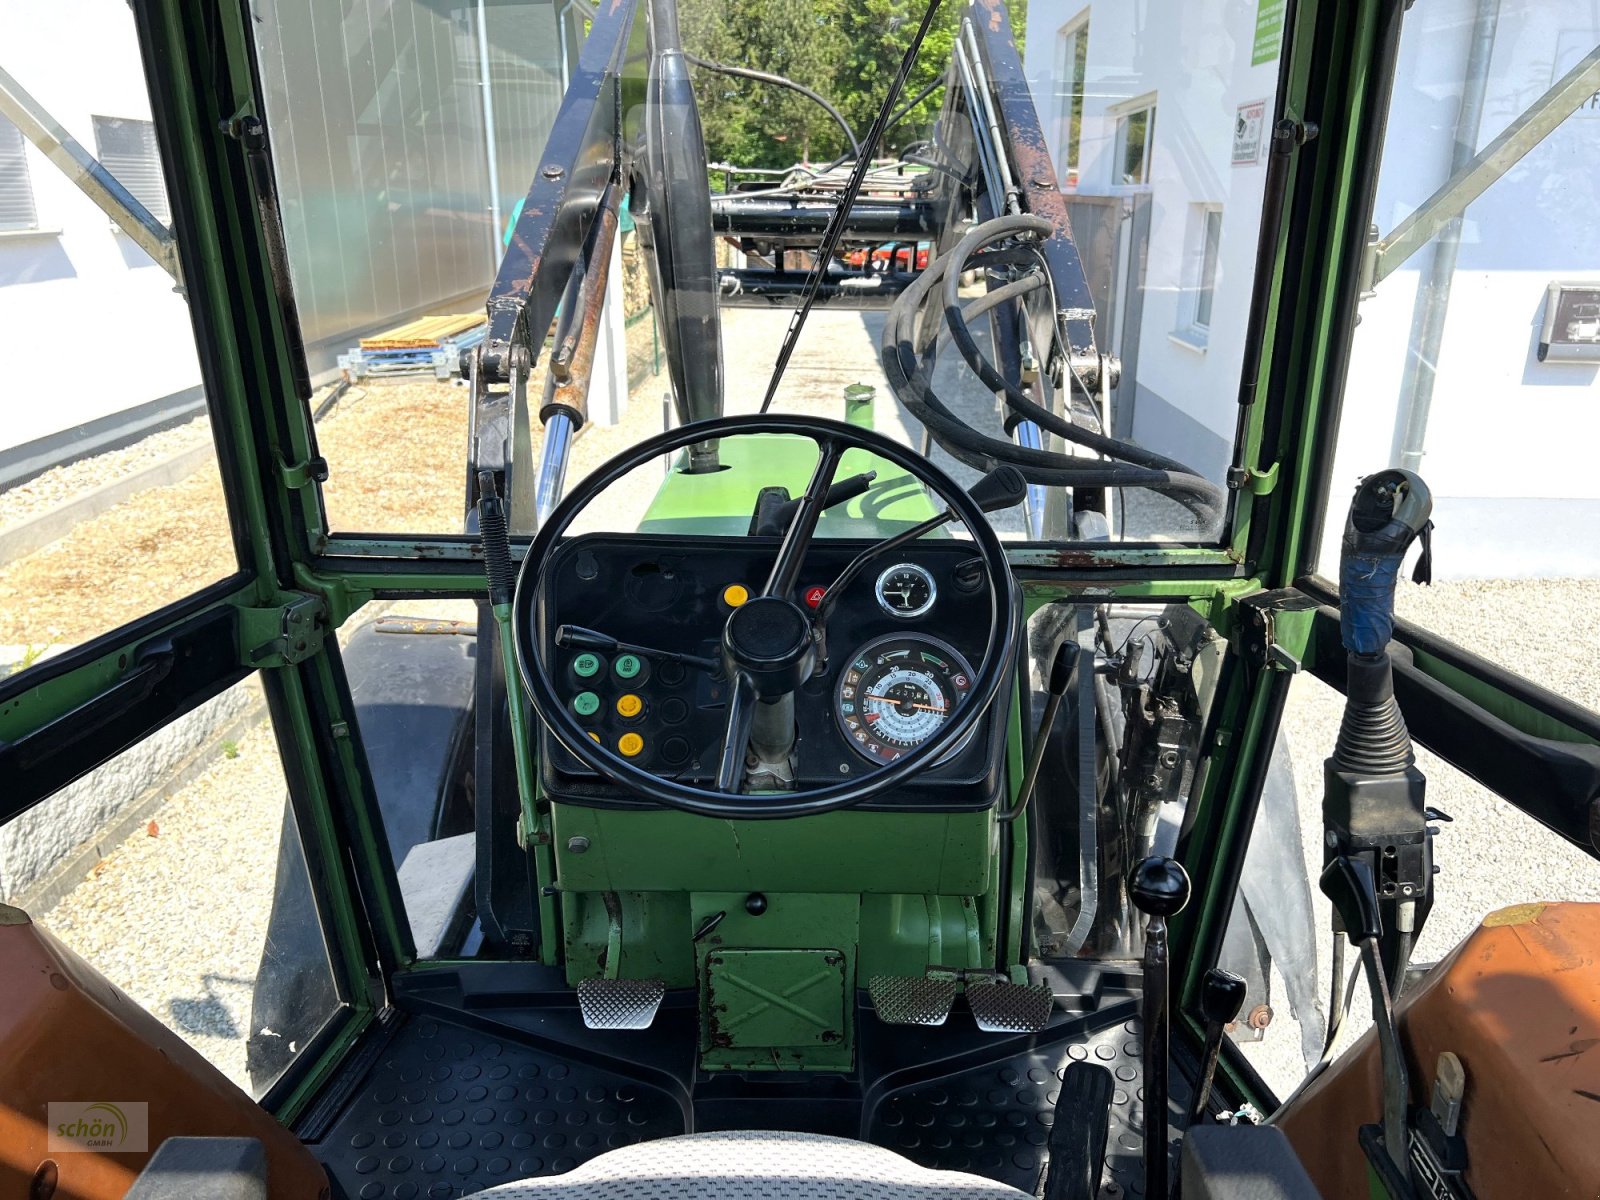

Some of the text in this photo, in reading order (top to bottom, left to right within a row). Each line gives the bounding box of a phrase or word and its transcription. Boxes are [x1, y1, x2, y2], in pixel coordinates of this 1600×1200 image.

[890, 665, 900, 673] 20
[924, 670, 934, 679] 30
[924, 678, 932, 686] 25
